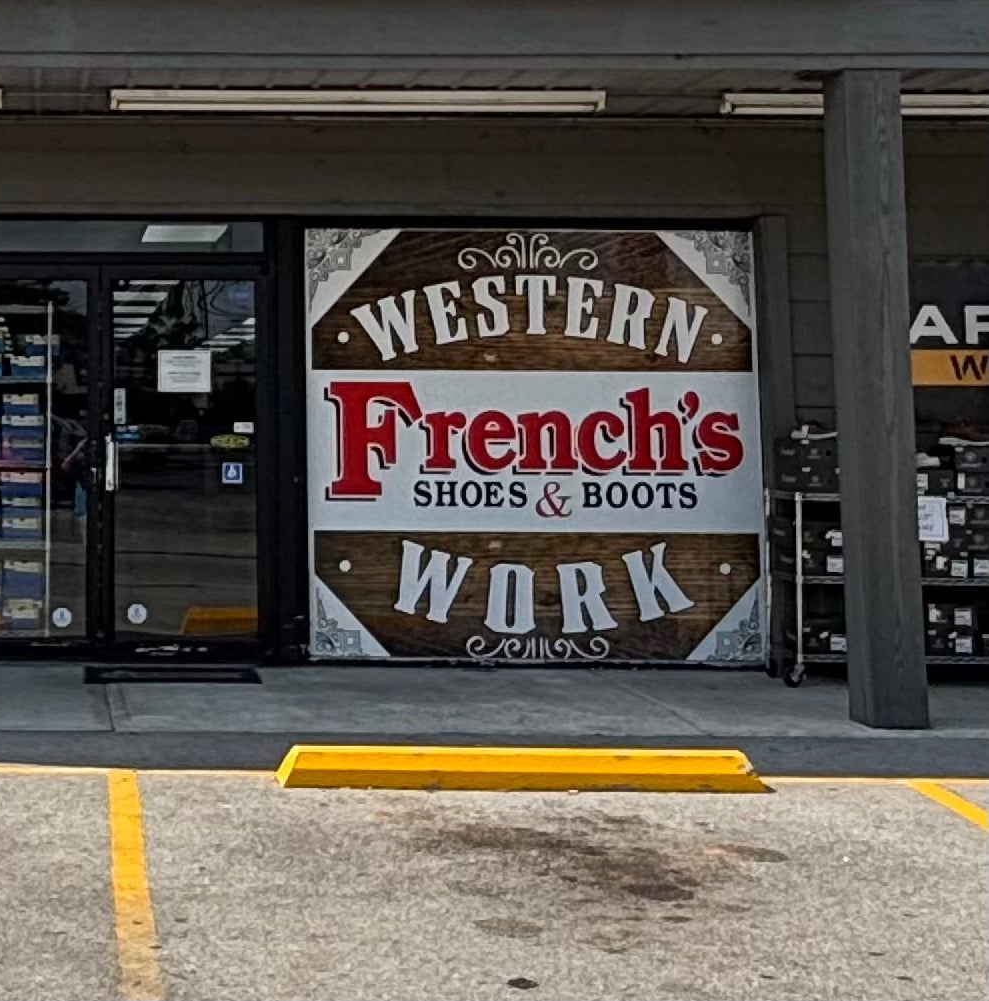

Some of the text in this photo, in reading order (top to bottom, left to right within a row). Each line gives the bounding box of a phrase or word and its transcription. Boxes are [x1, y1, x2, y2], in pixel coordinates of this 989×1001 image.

[350, 274, 708, 363] WESTERN
[323, 380, 745, 502] French's
[413, 480, 699, 518] SHOES & BOOTS
[394, 539, 695, 634] WORK
